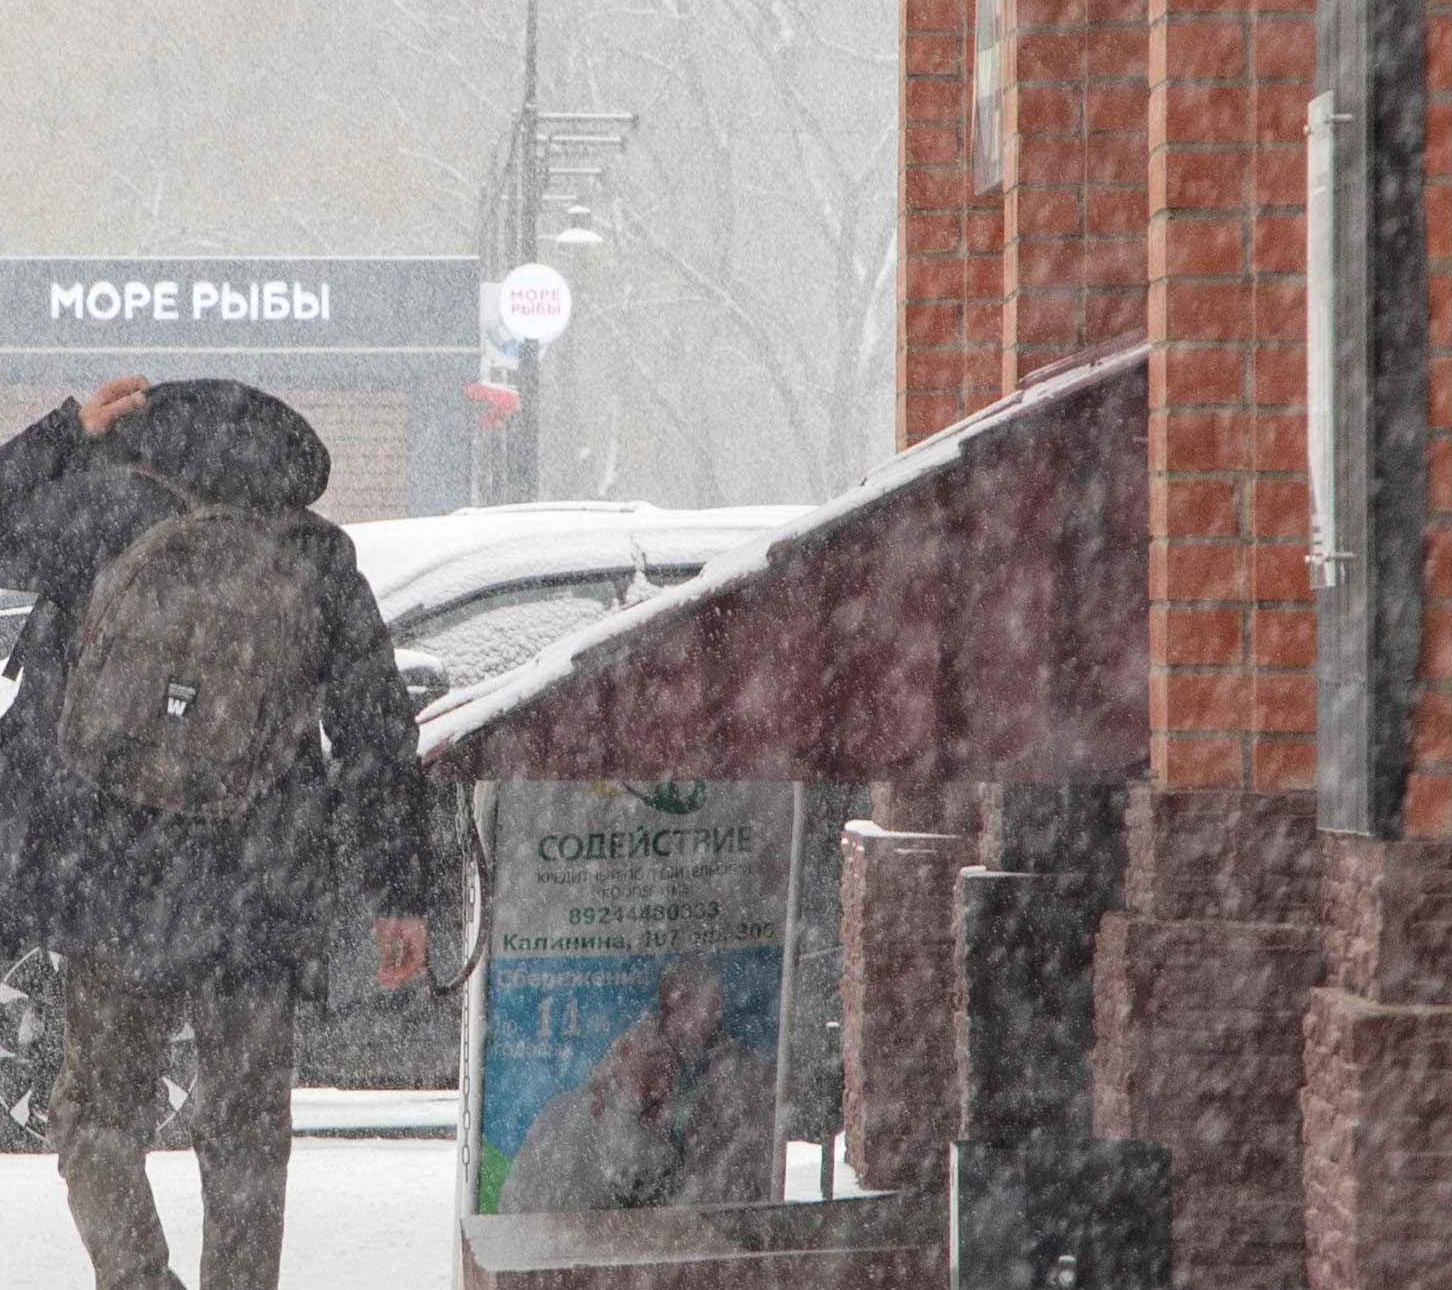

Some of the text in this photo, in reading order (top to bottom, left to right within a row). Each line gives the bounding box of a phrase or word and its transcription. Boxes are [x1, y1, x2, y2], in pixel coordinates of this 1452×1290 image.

[50, 281, 330, 321] МОРЕ РЫБЫ
[511, 289, 561, 301] МОРЕ
[511, 303, 561, 315] РЫБЫ
[167, 697, 187, 717] W
[538, 825, 753, 861] СОДЕЙСТВИЕ
